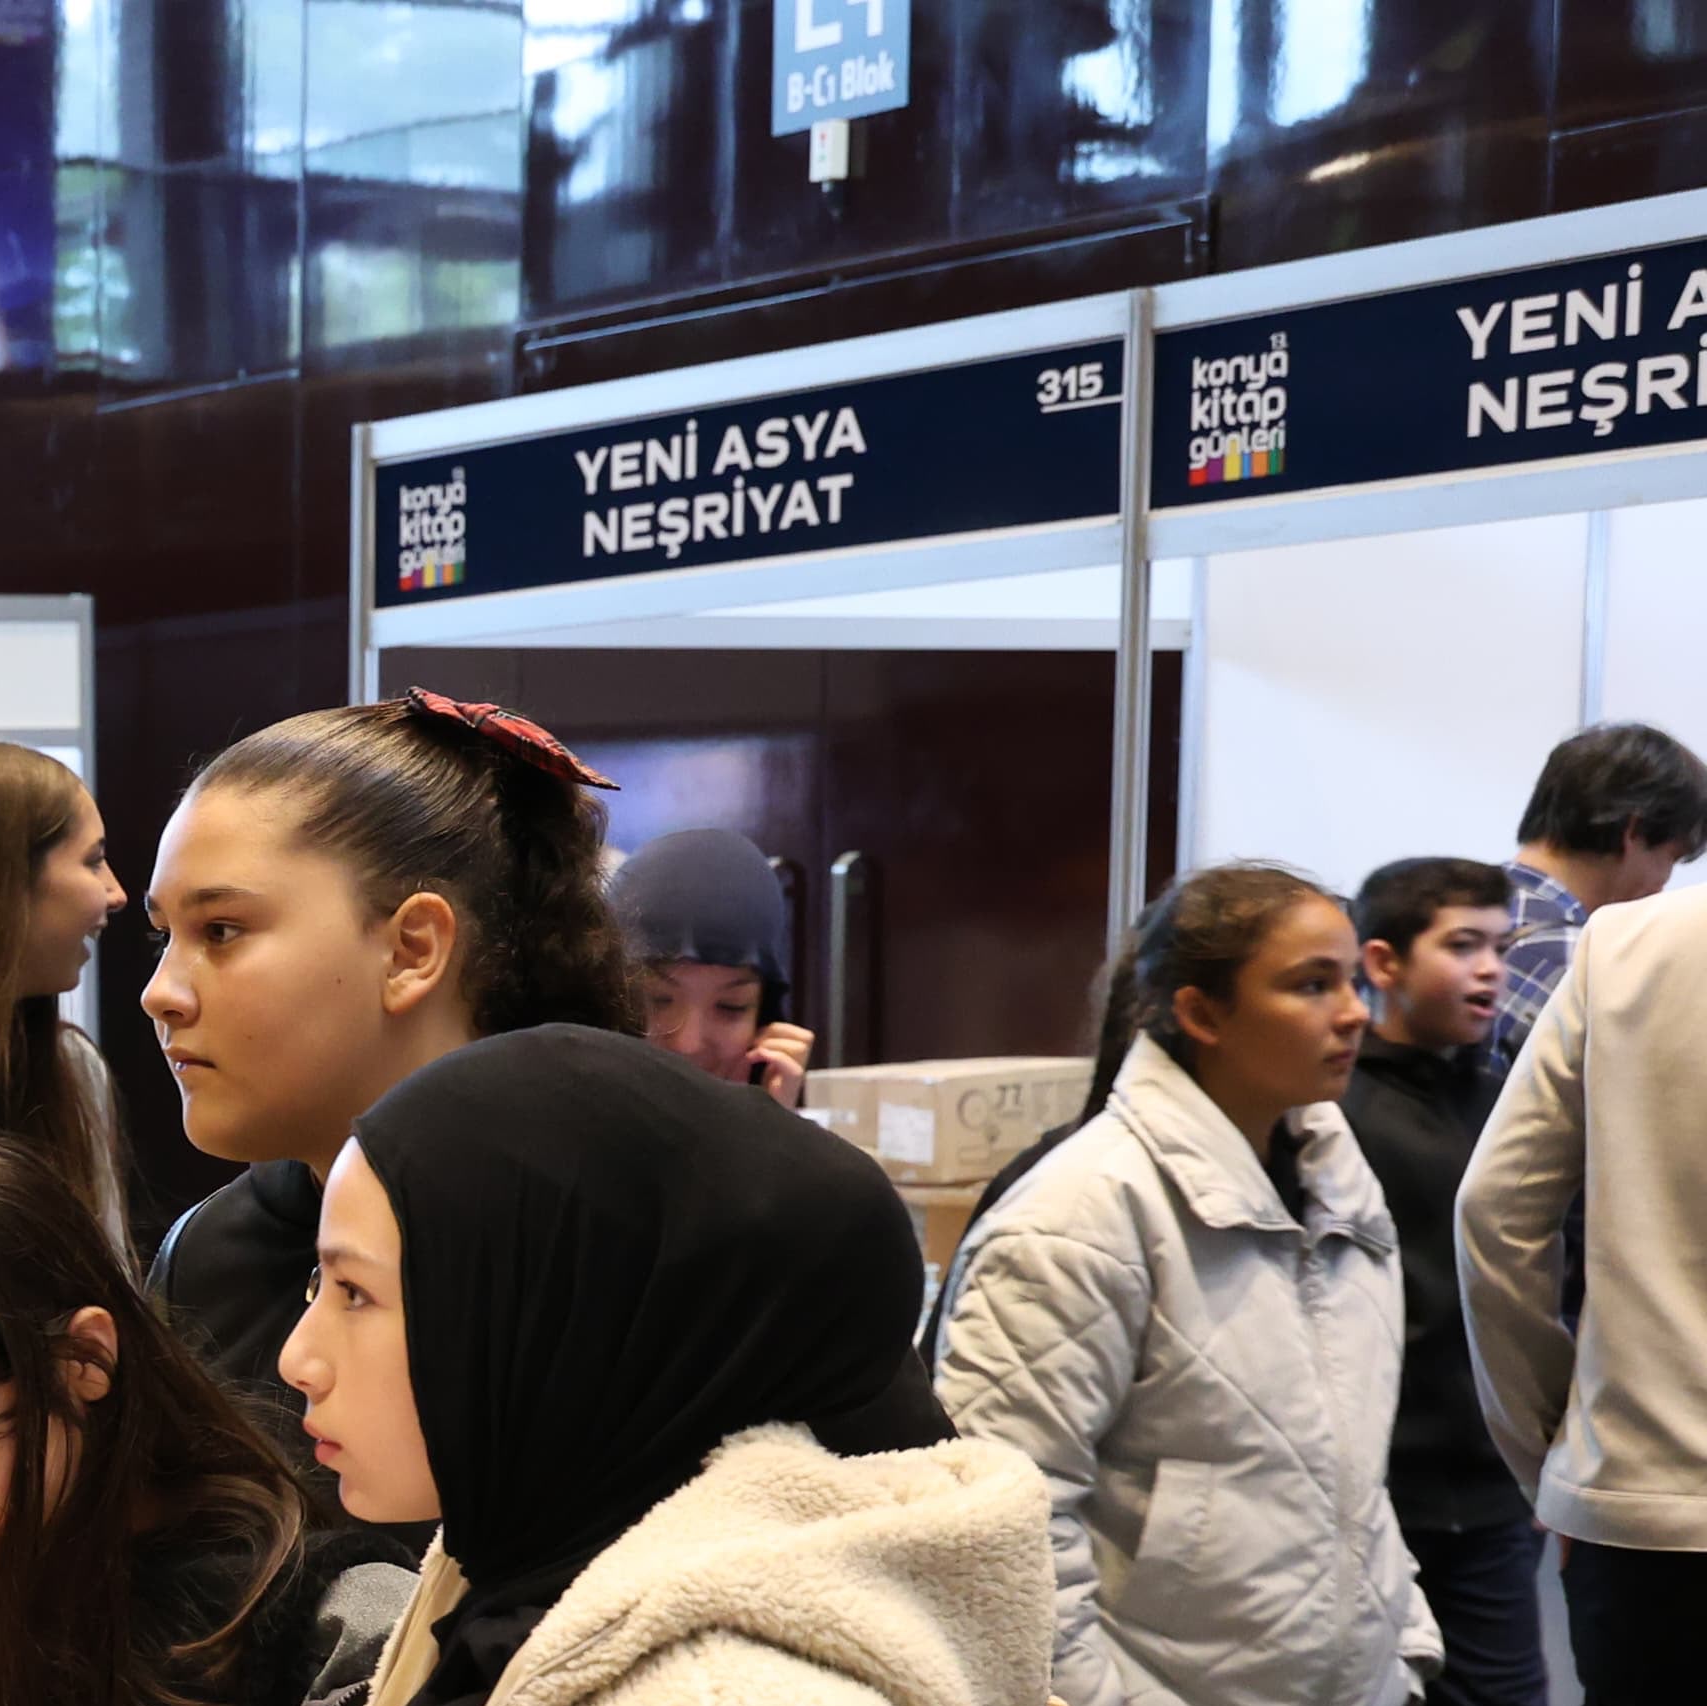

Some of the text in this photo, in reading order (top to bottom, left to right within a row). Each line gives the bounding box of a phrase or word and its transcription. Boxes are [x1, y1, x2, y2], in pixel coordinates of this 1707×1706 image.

[840, 50, 895, 101] Blok
[1457, 263, 1644, 361] YENİ
[1037, 363, 1103, 404] 315
[1191, 349, 1289, 391] konya
[1190, 386, 1287, 432] kitap
[576, 406, 867, 495] YENİ ASYA
[1189, 420, 1286, 471] günleri
[584, 474, 854, 560] NEŞRİYAT
